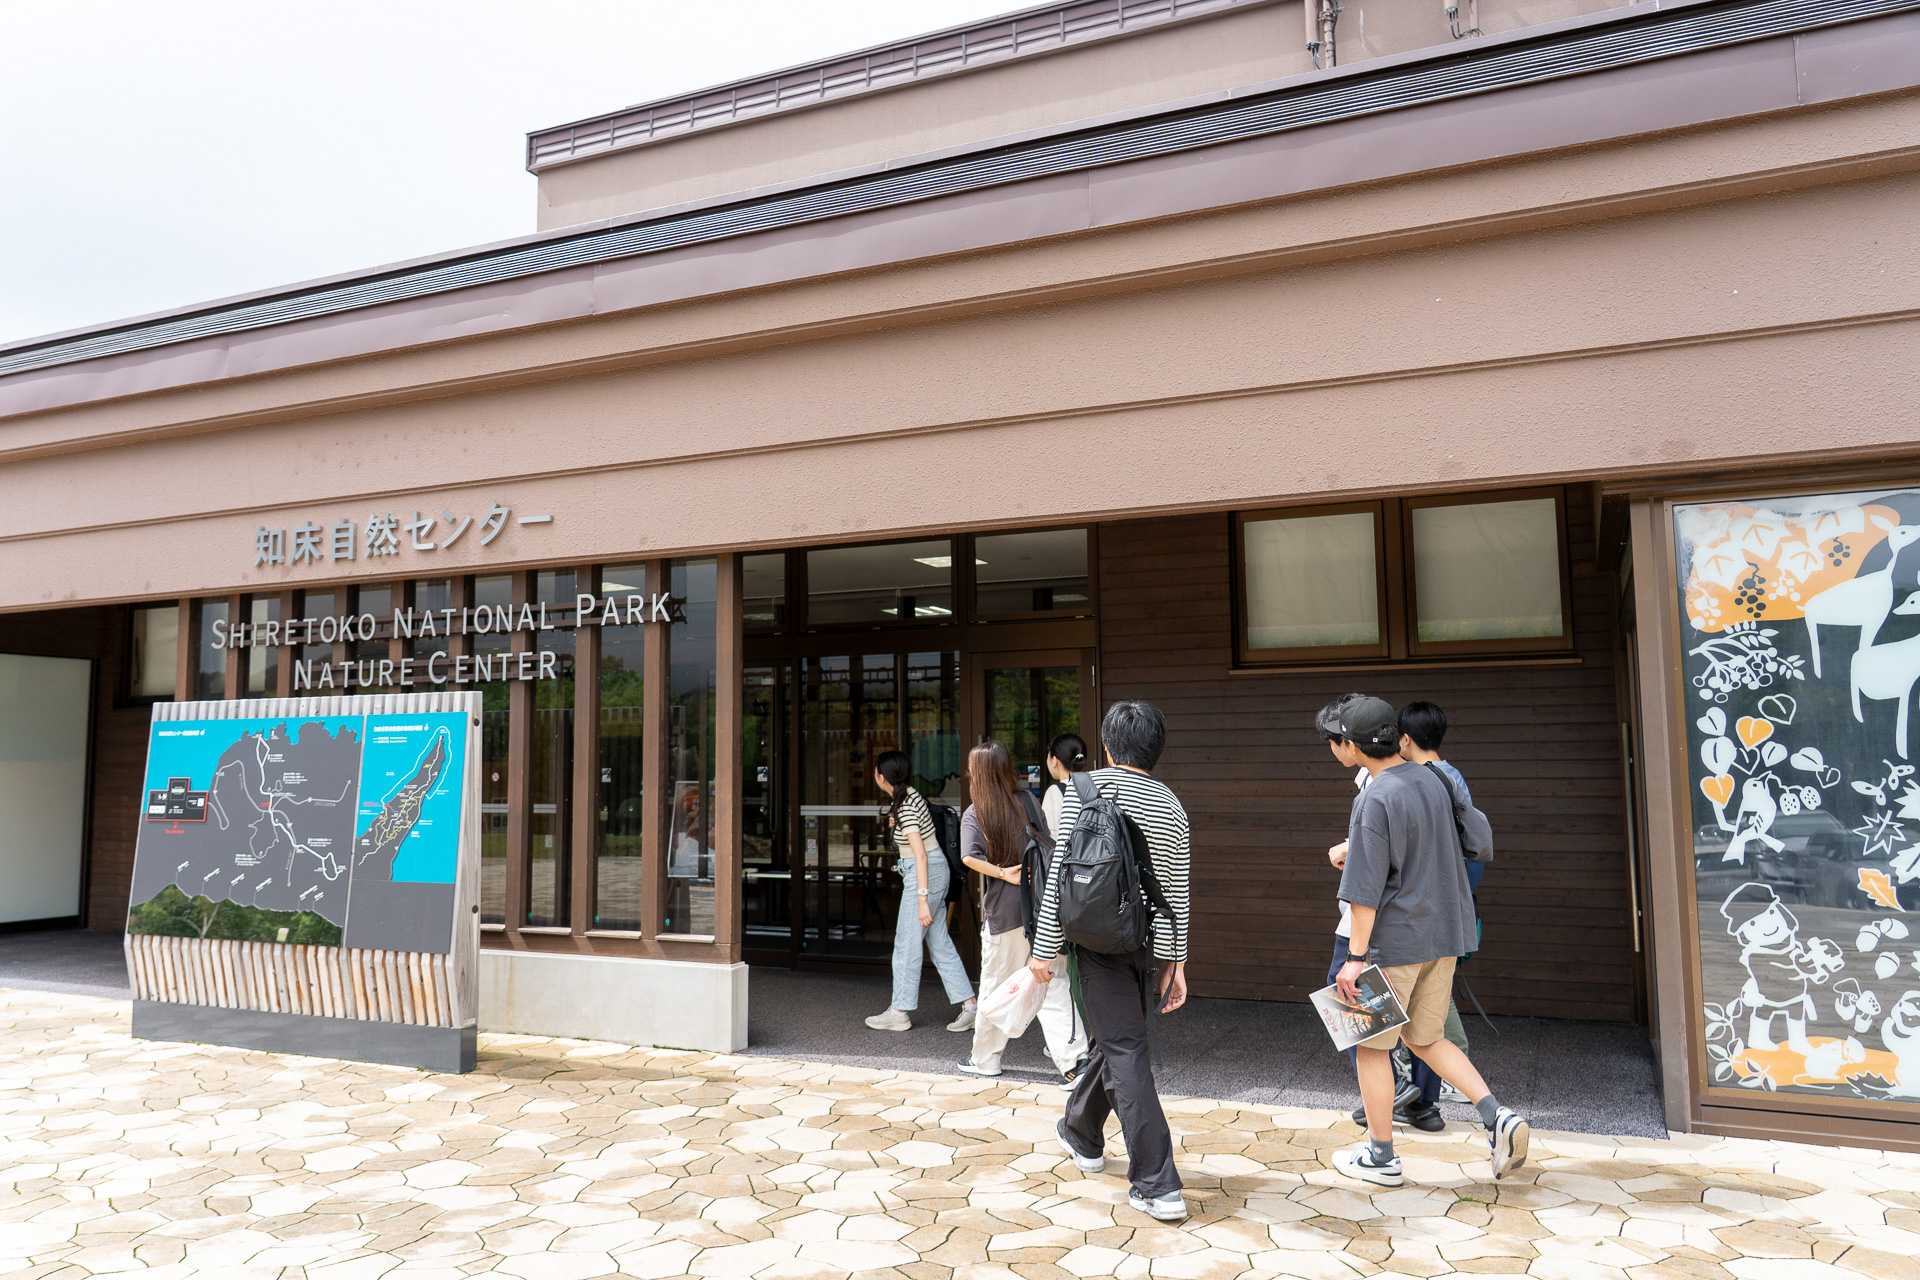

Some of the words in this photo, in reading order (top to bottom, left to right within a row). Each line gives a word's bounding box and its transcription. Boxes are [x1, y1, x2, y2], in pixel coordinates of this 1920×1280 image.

[253, 502, 554, 567] 知床自然センター
[211, 613, 376, 650] SHIRETOKO
[393, 601, 554, 639] NATIONAL
[576, 592, 671, 628] PARK
[294, 657, 415, 690] NATURE
[428, 650, 557, 684] CENTER
